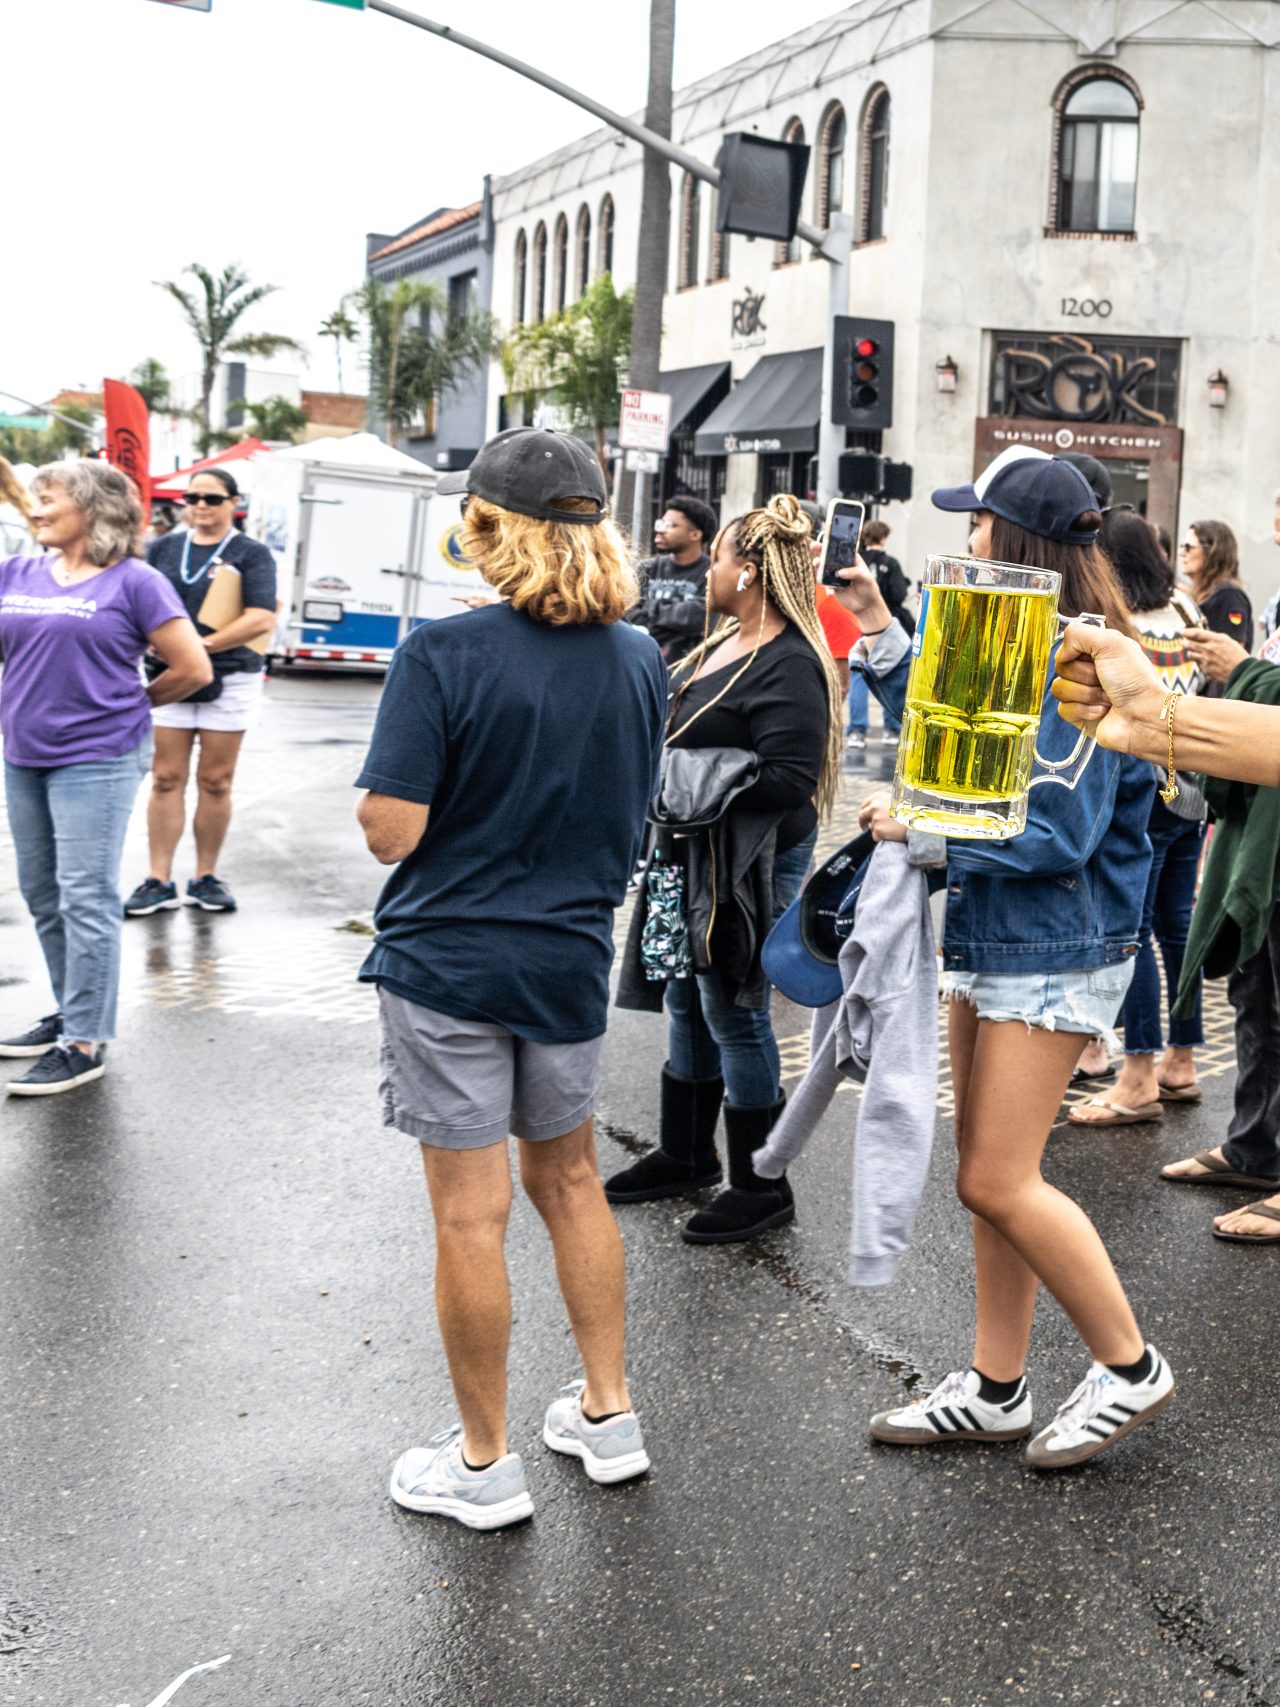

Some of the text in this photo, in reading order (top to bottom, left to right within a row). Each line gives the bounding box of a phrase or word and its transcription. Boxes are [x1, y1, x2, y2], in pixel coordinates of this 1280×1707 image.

[1061, 298, 1113, 318] 1200
[624, 392, 640, 408] NO
[626, 411, 664, 425] PARKING
[993, 430, 1161, 448] SUSHI KITCHEN
